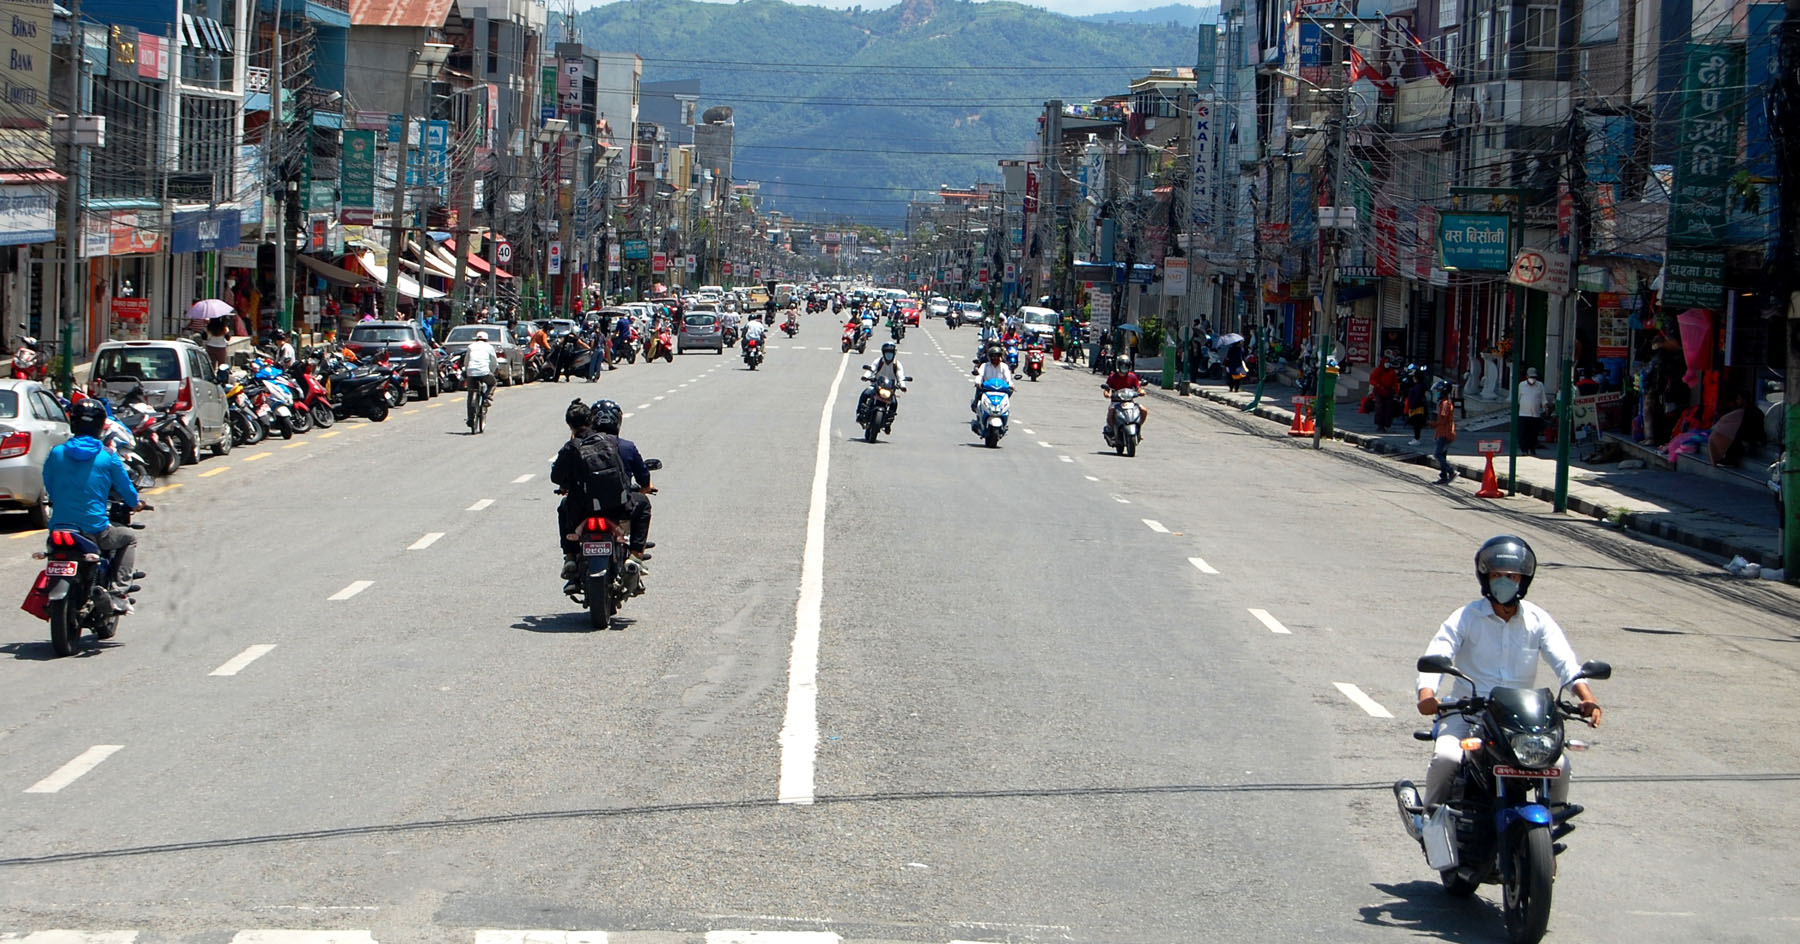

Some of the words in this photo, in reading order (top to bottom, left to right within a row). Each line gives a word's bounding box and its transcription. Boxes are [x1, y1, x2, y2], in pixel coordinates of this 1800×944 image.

[10, 48, 33, 71] BANK
[1195, 121, 1209, 195] KAILASH
[1444, 229, 1464, 243] बस
[498, 247, 510, 257] 40
[1548, 268, 1568, 276] HORN
[1547, 276, 1567, 284] AREA
